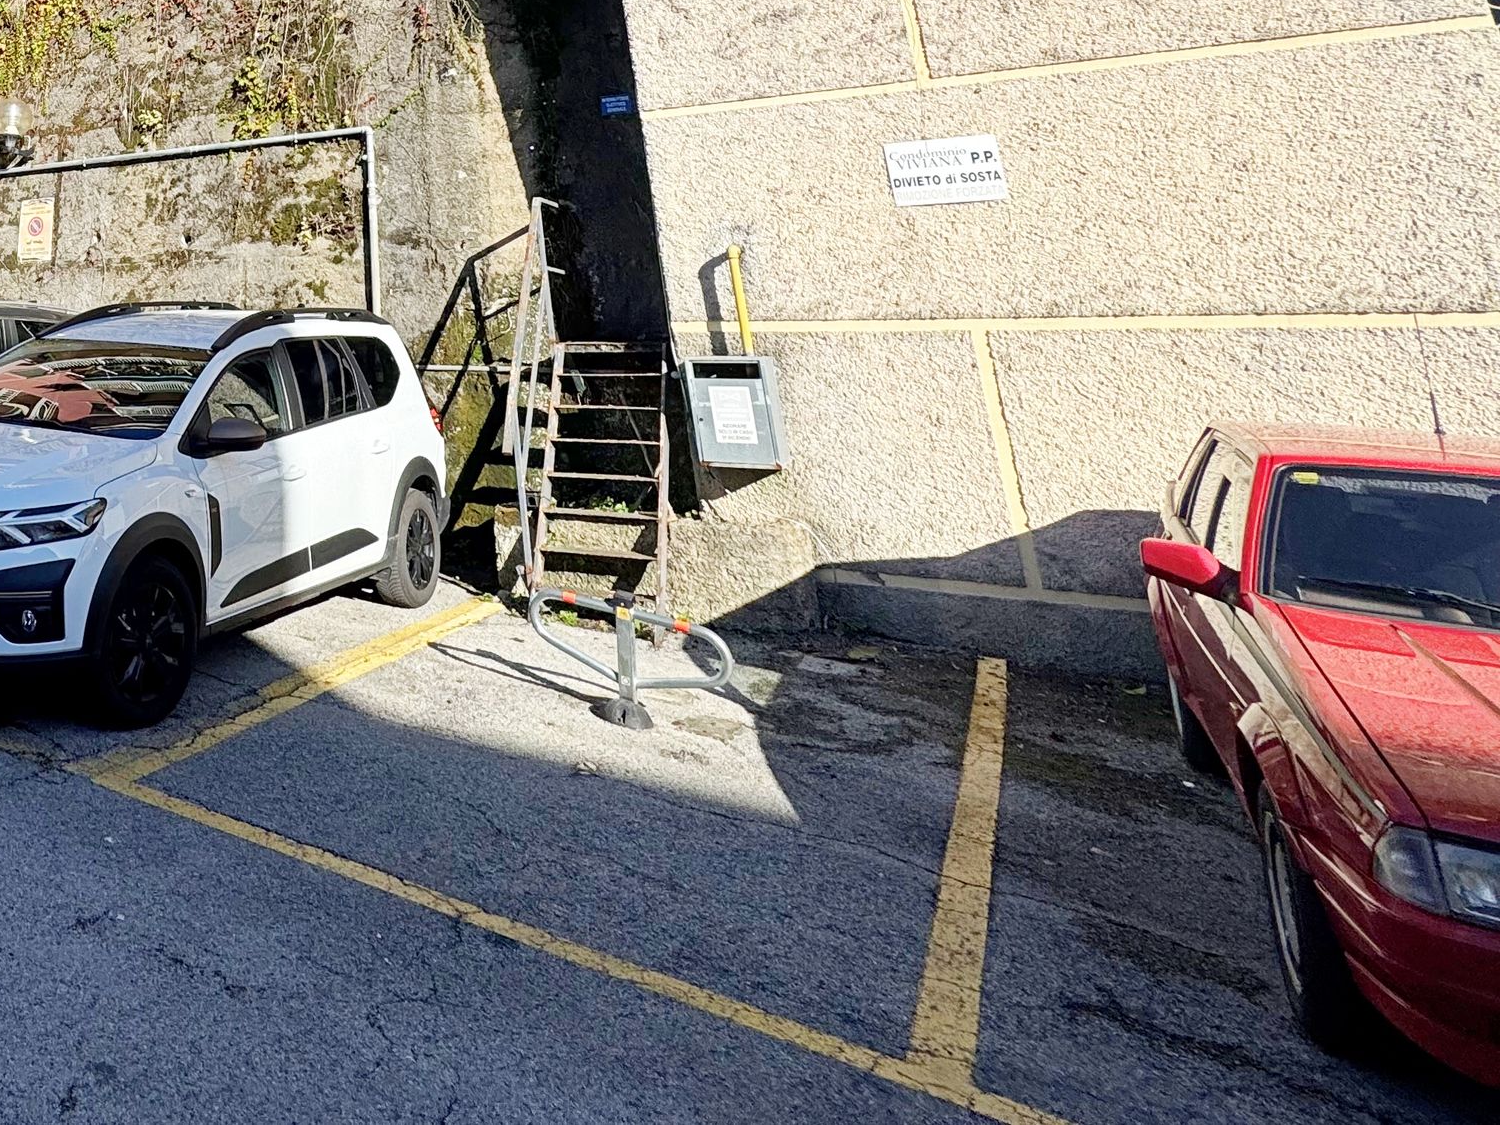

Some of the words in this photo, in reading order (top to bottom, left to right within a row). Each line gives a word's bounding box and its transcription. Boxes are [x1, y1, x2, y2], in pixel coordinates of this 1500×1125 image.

[889, 147, 967, 161] Condominio
[970, 150, 998, 164] P.P.
[895, 155, 963, 170] VIVIANA
[893, 174, 941, 188] DIVIETO
[945, 173, 957, 185] di
[960, 170, 1002, 183] SOSTA
[895, 187, 953, 202] RIMOZIONE
[956, 185, 1005, 198] FORZATA
